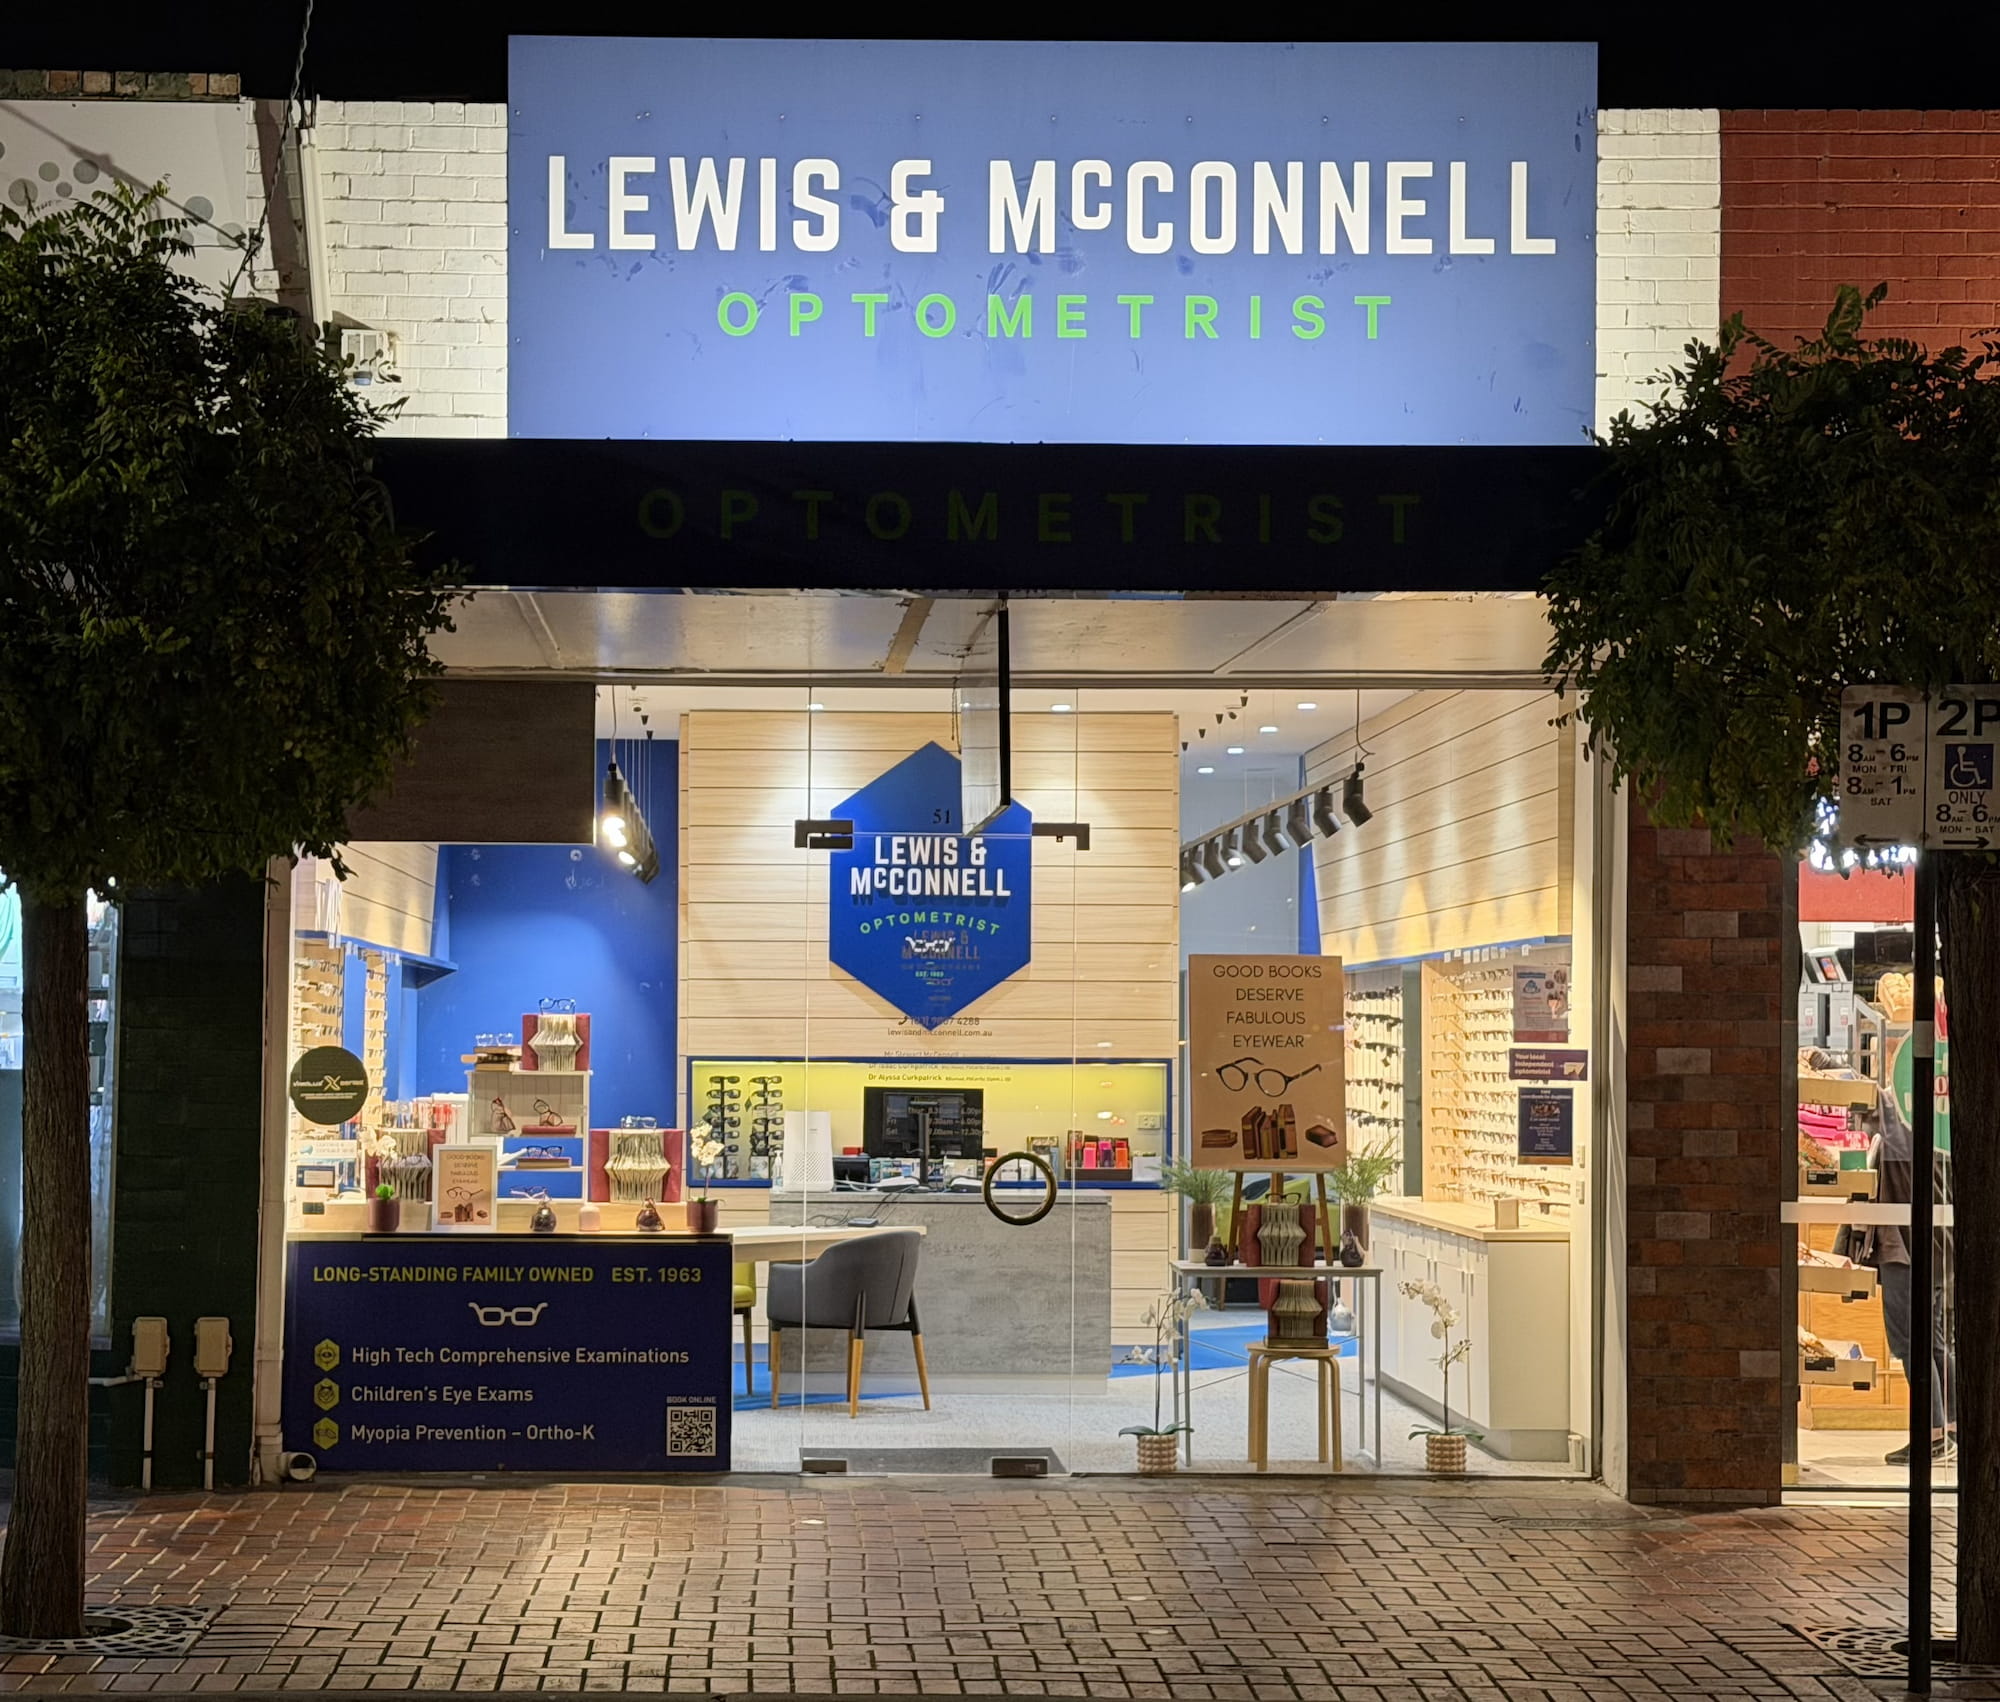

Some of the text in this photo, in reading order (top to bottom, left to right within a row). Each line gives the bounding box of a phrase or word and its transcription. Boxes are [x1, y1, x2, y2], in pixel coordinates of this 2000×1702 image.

[548, 155, 841, 253] LEWIS
[889, 158, 945, 254] &
[716, 291, 1394, 341] OPTOMETRIST
[637, 488, 1424, 545] OPTOMETRIST
[1853, 702, 1910, 739] 1P
[1936, 699, 2000, 736] 2P
[1848, 744, 1876, 763] 8AM
[1890, 744, 1919, 762] 6PM
[1852, 765, 1877, 774] MON
[1890, 765, 1907, 773] FRI
[1846, 777, 1875, 795] 8AM
[1890, 776, 1916, 795] 1PM
[1871, 797, 1892, 806] SAT
[1948, 791, 1986, 805] ONLY
[932, 810, 951, 825] 51
[1939, 825, 1962, 833] MON
[1975, 825, 1995, 833] SAT
[875, 836, 988, 866] LEWIS &
[859, 912, 1001, 936] OPTOMETRIST
[1213, 965, 1322, 978] GOOD BOOKS
[1236, 988, 1304, 1001] DESERVE
[1226, 1011, 1306, 1024] FABULOUS
[1233, 1034, 1304, 1048] EYEWEAR
[868, 1073, 877, 1081] Dr
[313, 1267, 701, 1283] LONG-STANDING FAMILY OWNED EST. 1963
[352, 1347, 690, 1367] High Tech Comprehensive Examinations
[442, 1387, 473, 1407] Eye
[477, 1386, 534, 1403] Exams
[351, 1424, 410, 1445] Myopia
[415, 1424, 507, 1441] Prevention
[526, 1424, 595, 1441] Ortho-K
